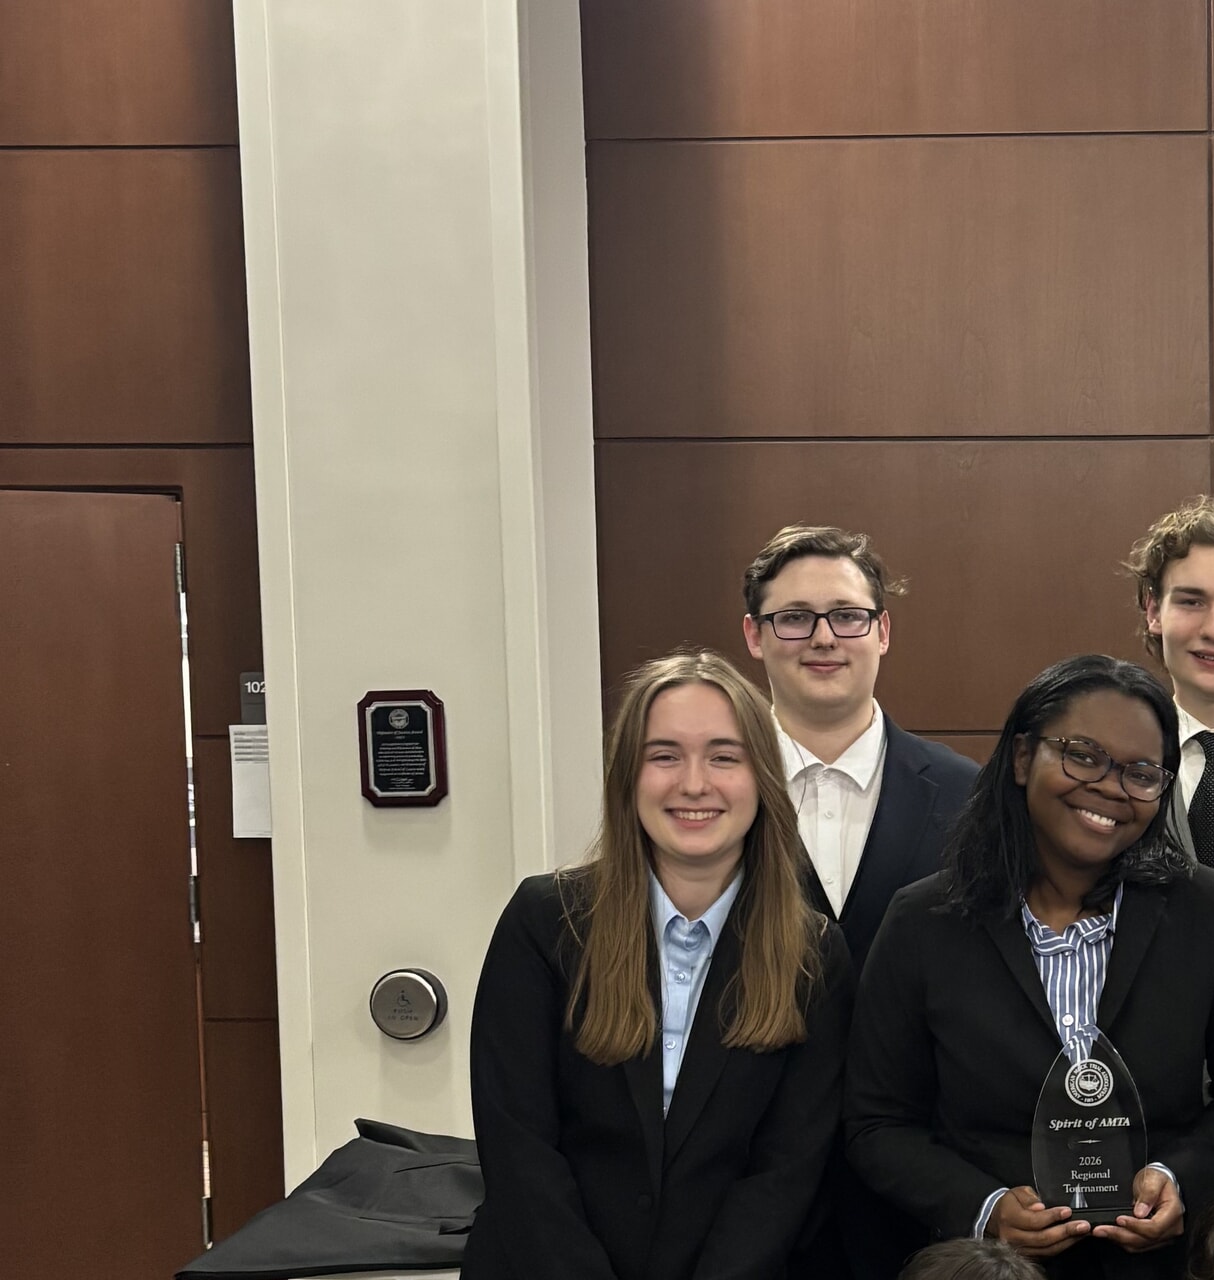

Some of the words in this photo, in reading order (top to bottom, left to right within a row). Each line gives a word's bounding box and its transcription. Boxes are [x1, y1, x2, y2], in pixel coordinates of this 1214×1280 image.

[244, 681, 265, 693] 102
[1049, 1119, 1082, 1131] Spirit
[1084, 1117, 1099, 1129] of
[1099, 1117, 1131, 1127] AMTA
[1079, 1156, 1102, 1166] 2026
[1071, 1168, 1111, 1181] Regional
[1062, 1183, 1119, 1193] Tournament
